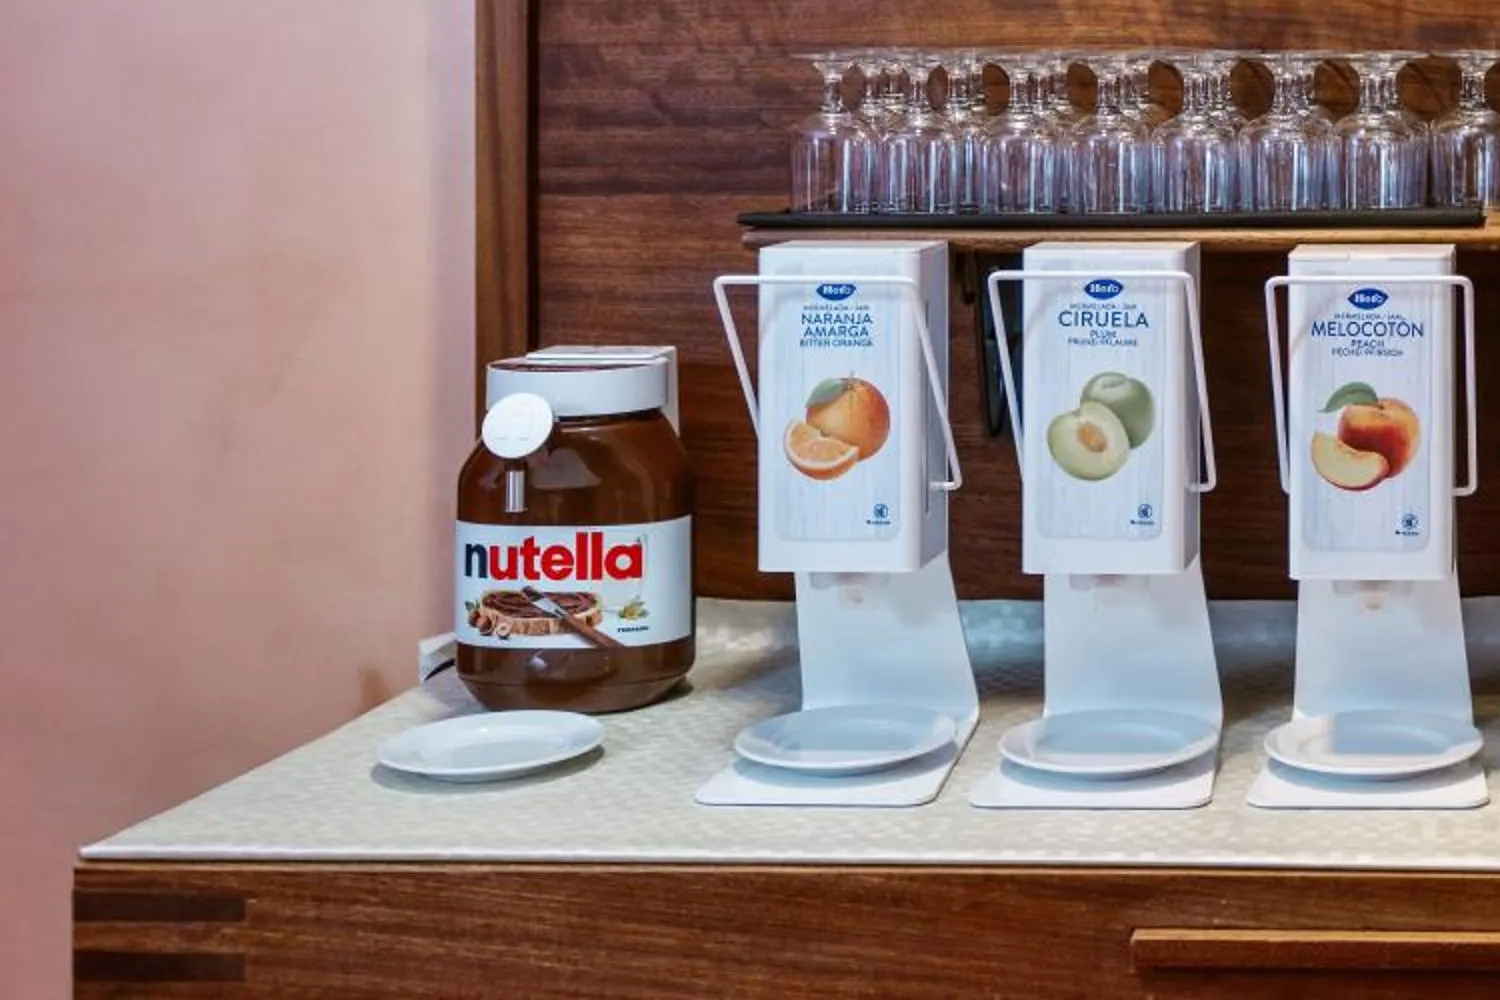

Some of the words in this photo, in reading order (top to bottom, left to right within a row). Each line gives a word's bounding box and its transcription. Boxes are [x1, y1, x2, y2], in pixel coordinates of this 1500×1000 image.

[801, 313, 873, 325] NARANJA
[1058, 311, 1149, 328] CIRUELA
[804, 325, 869, 337] AMARGA
[464, 531, 644, 581] nutella
